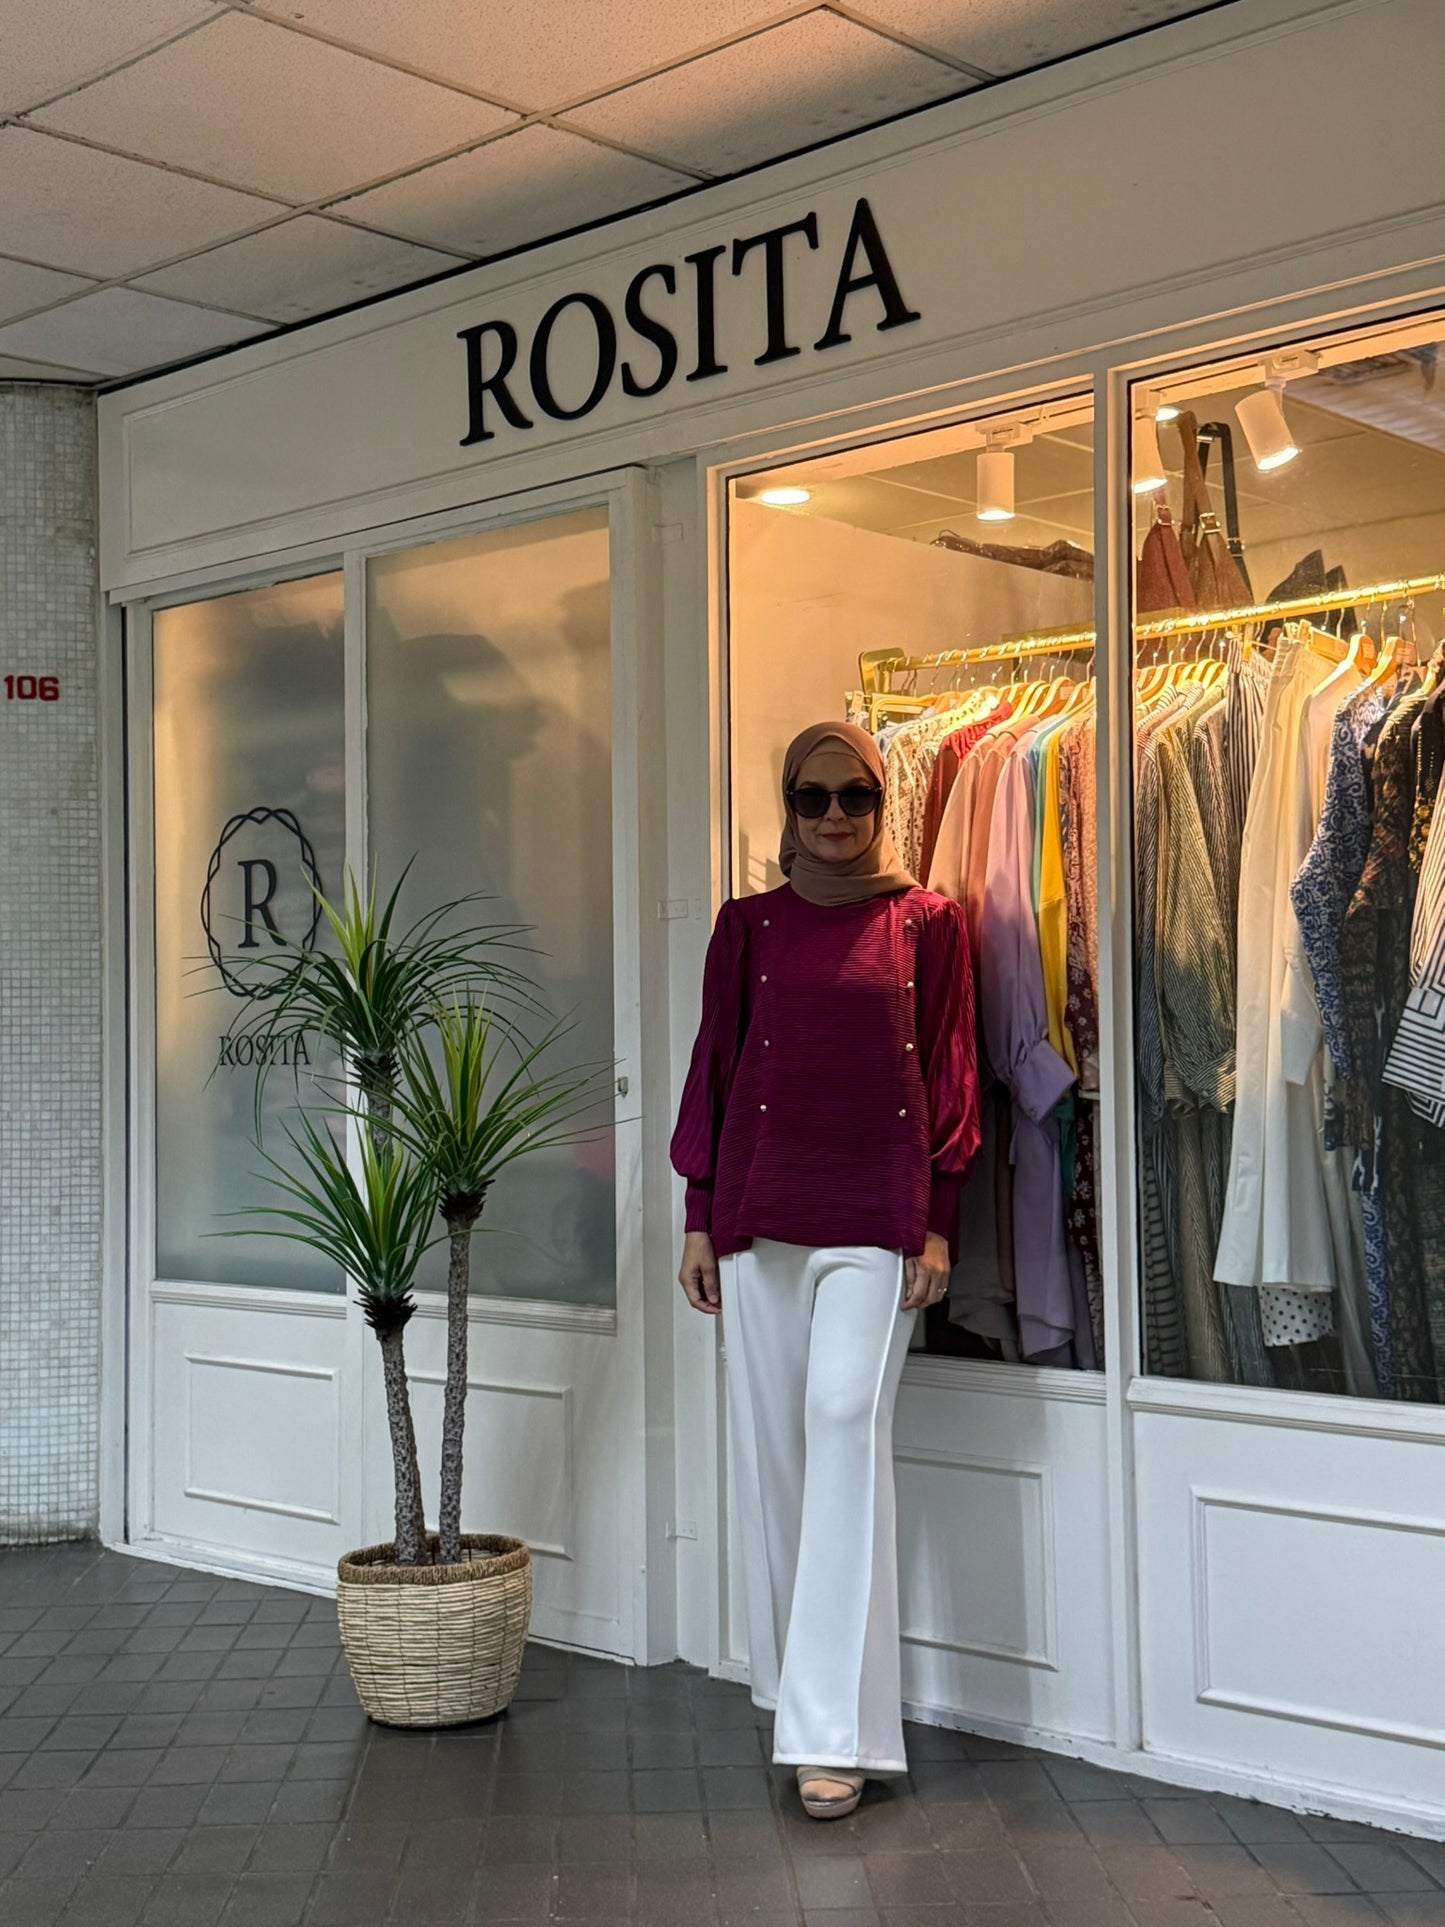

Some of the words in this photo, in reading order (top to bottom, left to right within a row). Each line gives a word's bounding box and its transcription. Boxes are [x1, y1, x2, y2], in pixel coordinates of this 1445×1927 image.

[456, 197, 921, 447] ROSITA
[4, 674, 60, 702] 106
[237, 859, 287, 948] R
